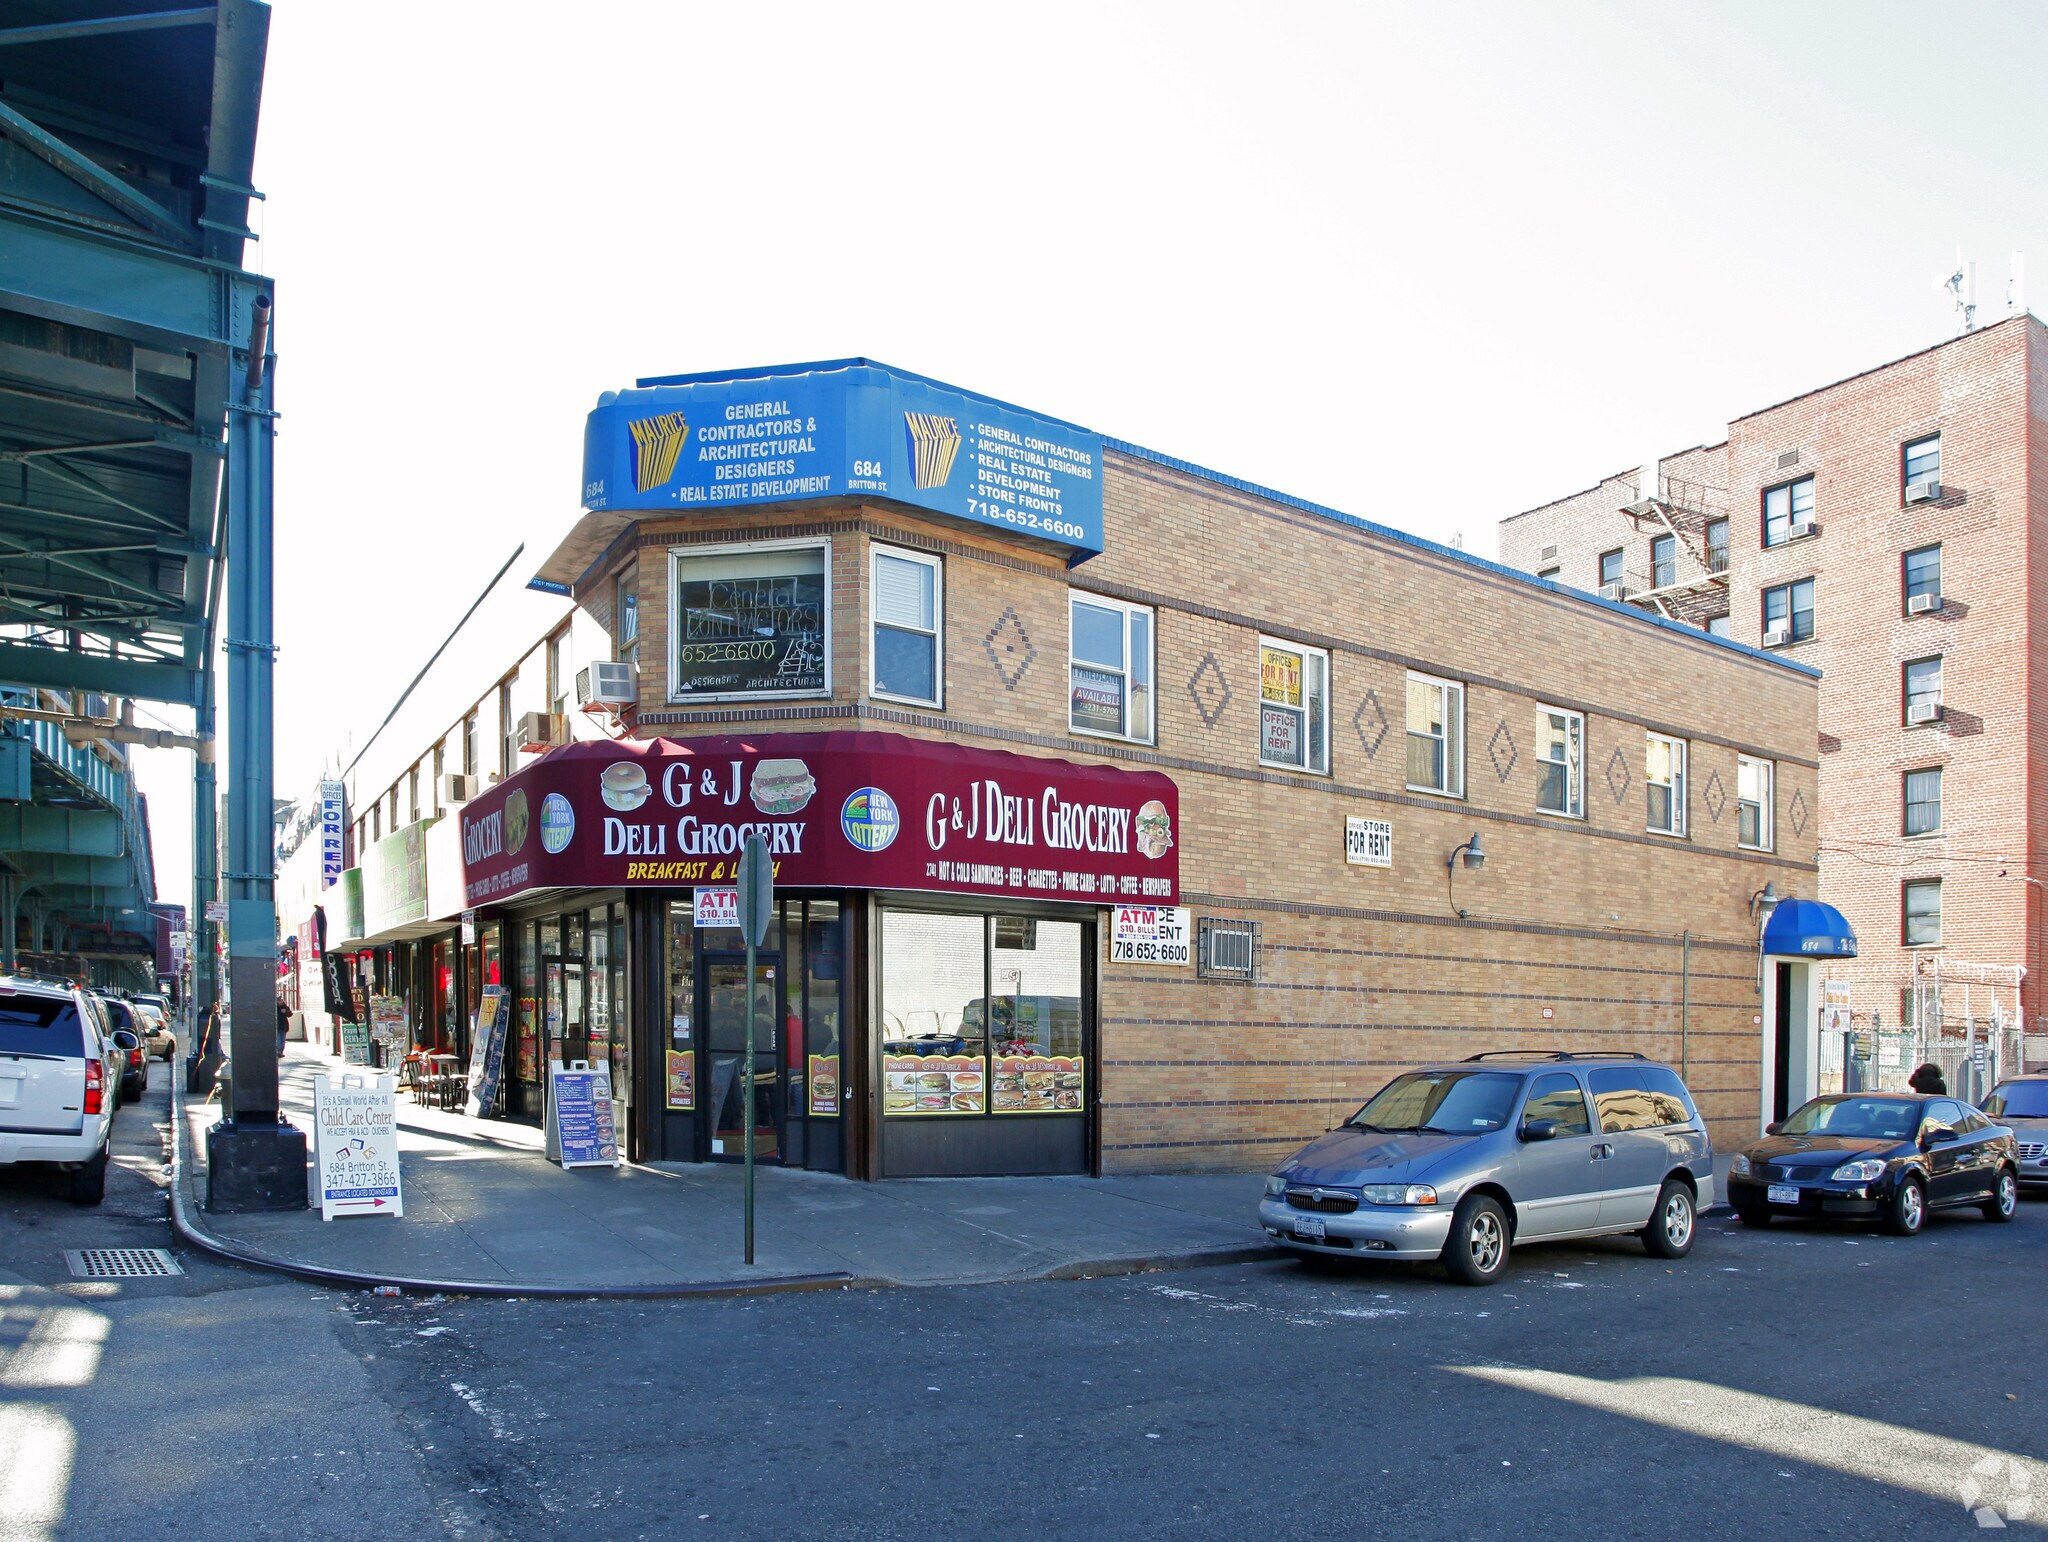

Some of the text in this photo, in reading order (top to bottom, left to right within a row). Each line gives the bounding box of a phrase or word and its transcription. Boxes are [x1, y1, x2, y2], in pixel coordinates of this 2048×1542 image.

[725, 401, 790, 420] GENERAL
[698, 416, 817, 442] CONTRACTORS &
[698, 437, 815, 461] ARCHITECTURAL
[978, 423, 1092, 464] GENERAL CONTRACTORS
[854, 460, 882, 477] 684
[977, 438, 1092, 480] ARCHITECTURAL DESIGNERS
[978, 453, 1052, 484] REAL ESTATE
[715, 459, 795, 480] DESIGNERS
[587, 480, 604, 498] 684
[680, 476, 830, 502] REAL ESTATE DEVELOPMENT
[849, 480, 888, 491] BRITTON ST.
[978, 469, 1061, 500] DEVELOPMENT
[978, 484, 1062, 516] STORE FRONTS
[967, 498, 1084, 540] 718-652-6600
[687, 607, 818, 637] CONTRACTORS
[682, 641, 775, 662] 652-6600
[1268, 653, 1292, 668] OFFICES
[1261, 663, 1298, 684] FOR RNT
[1076, 689, 1120, 705] AVAILABLE
[1264, 713, 1295, 727] OFFICE
[1271, 726, 1288, 739] FOR
[1268, 737, 1291, 751] RENT
[663, 761, 743, 808] G & J
[553, 800, 566, 812] NEW
[869, 794, 888, 808] NEW
[323, 800, 342, 833] FOR
[552, 812, 571, 824] YORK
[869, 808, 893, 822] YORK
[926, 780, 1131, 853] G & J DELI GROCERY
[603, 815, 807, 855] DELI GROCERY
[845, 820, 896, 848] LOTTERY
[1364, 820, 1389, 833] STORE
[464, 810, 502, 866] GROCERY
[1349, 830, 1390, 857] FOR RENT
[627, 862, 708, 880] BREAKFAST
[710, 864, 725, 879] &
[939, 861, 950, 881] HOT
[957, 862, 970, 883] COLD
[971, 864, 1004, 886] SANDWICHES
[1009, 867, 1022, 887] BEER
[1027, 868, 1057, 890] CIGARETTES
[1063, 872, 1078, 891] PHONE
[1080, 872, 1095, 892] CARDS
[1100, 874, 1115, 893] LOTTO
[1120, 876, 1138, 895] COFFEE
[1142, 877, 1171, 897] NEWSPAPERS
[723, 910, 737, 918] BIL
[1120, 910, 1155, 925] ATM
[1138, 926, 1156, 935] BILLS
[1115, 942, 1187, 962] 718 652-6600
[1802, 941, 1818, 951] 684
[338, 1095, 351, 1105] Small
[353, 1095, 367, 1105] World
[369, 1095, 380, 1105] After
[321, 1106, 391, 1126] Child Care Center
[330, 1161, 390, 1174] 684 Britton St.
[326, 1172, 395, 1188] 347-427-3866
[331, 1190, 351, 1199] ENTRANCE
[351, 1189, 369, 1198] LOCATED
